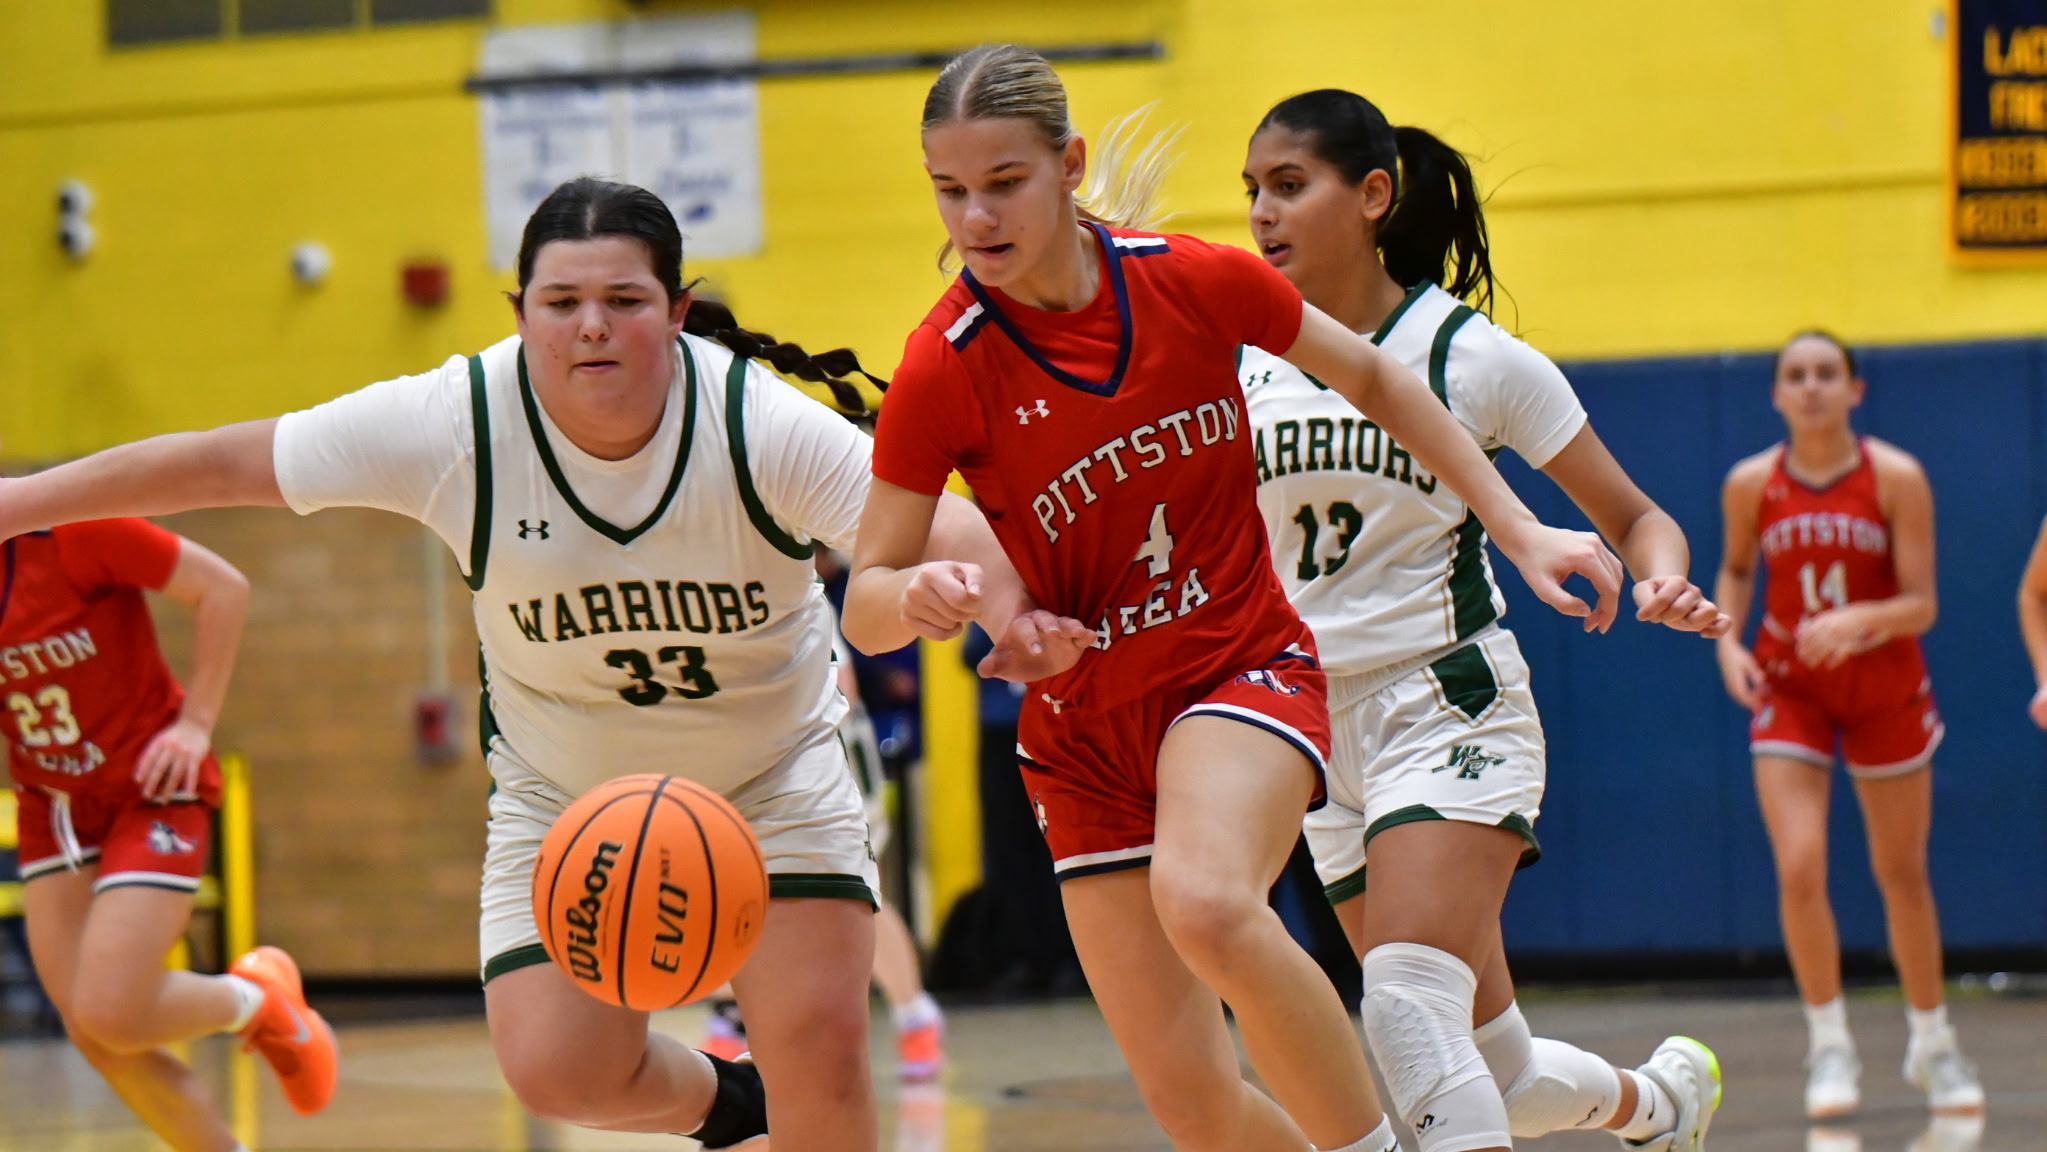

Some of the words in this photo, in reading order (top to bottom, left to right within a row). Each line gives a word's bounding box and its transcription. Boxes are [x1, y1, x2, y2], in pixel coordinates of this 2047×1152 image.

[1032, 397, 1239, 544] PITTSTON
[1255, 418, 1437, 495] ARRIOR
[1133, 502, 1175, 579] 4
[1292, 501, 1363, 581] 13
[508, 580, 769, 643] WARRIORS
[1799, 562, 1849, 614] 14
[0, 628, 98, 684] STON
[603, 646, 720, 707] 33
[8, 685, 80, 746] 23
[566, 840, 624, 982] Wilson
